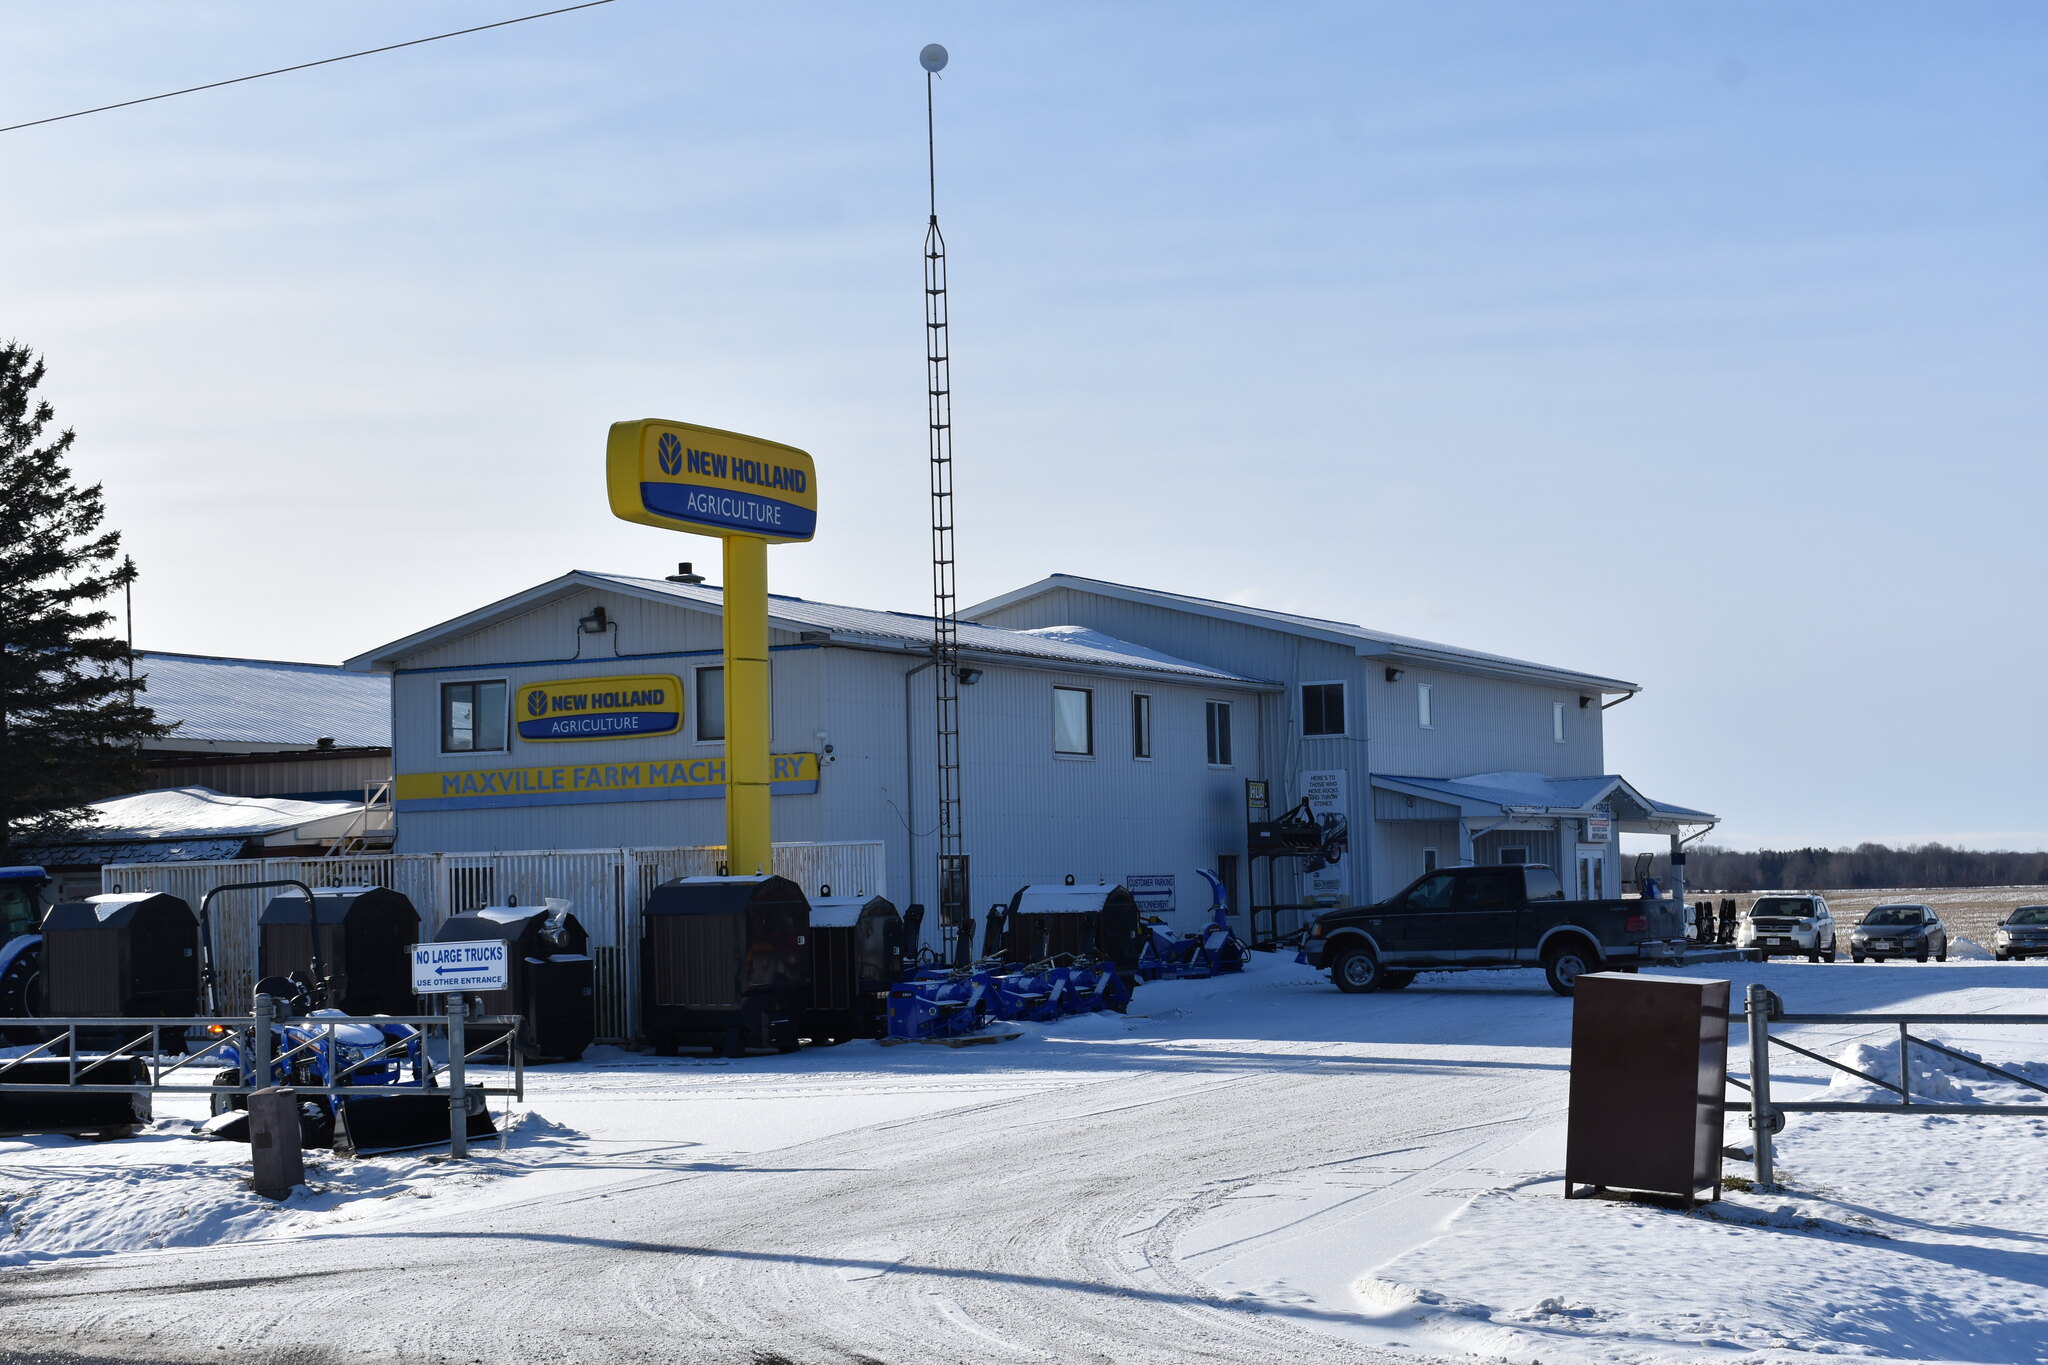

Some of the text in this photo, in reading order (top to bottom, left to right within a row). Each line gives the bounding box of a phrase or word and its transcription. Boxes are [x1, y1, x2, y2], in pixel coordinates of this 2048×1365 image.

[686, 448, 807, 494] NEW HOLLAND
[687, 491, 781, 525] AGRICULTURE
[551, 689, 665, 712] NEW HOLLAND
[551, 716, 639, 734] AGRICULTURE
[442, 756, 805, 795] MAXVILLE FARM MACHRY
[1250, 785, 1264, 798] HLA
[1129, 878, 1174, 887] CUSTOMER PARKING
[416, 946, 503, 965] NO LARGE TRUCKS
[416, 975, 502, 987] USE OTHER ENTRANCE
